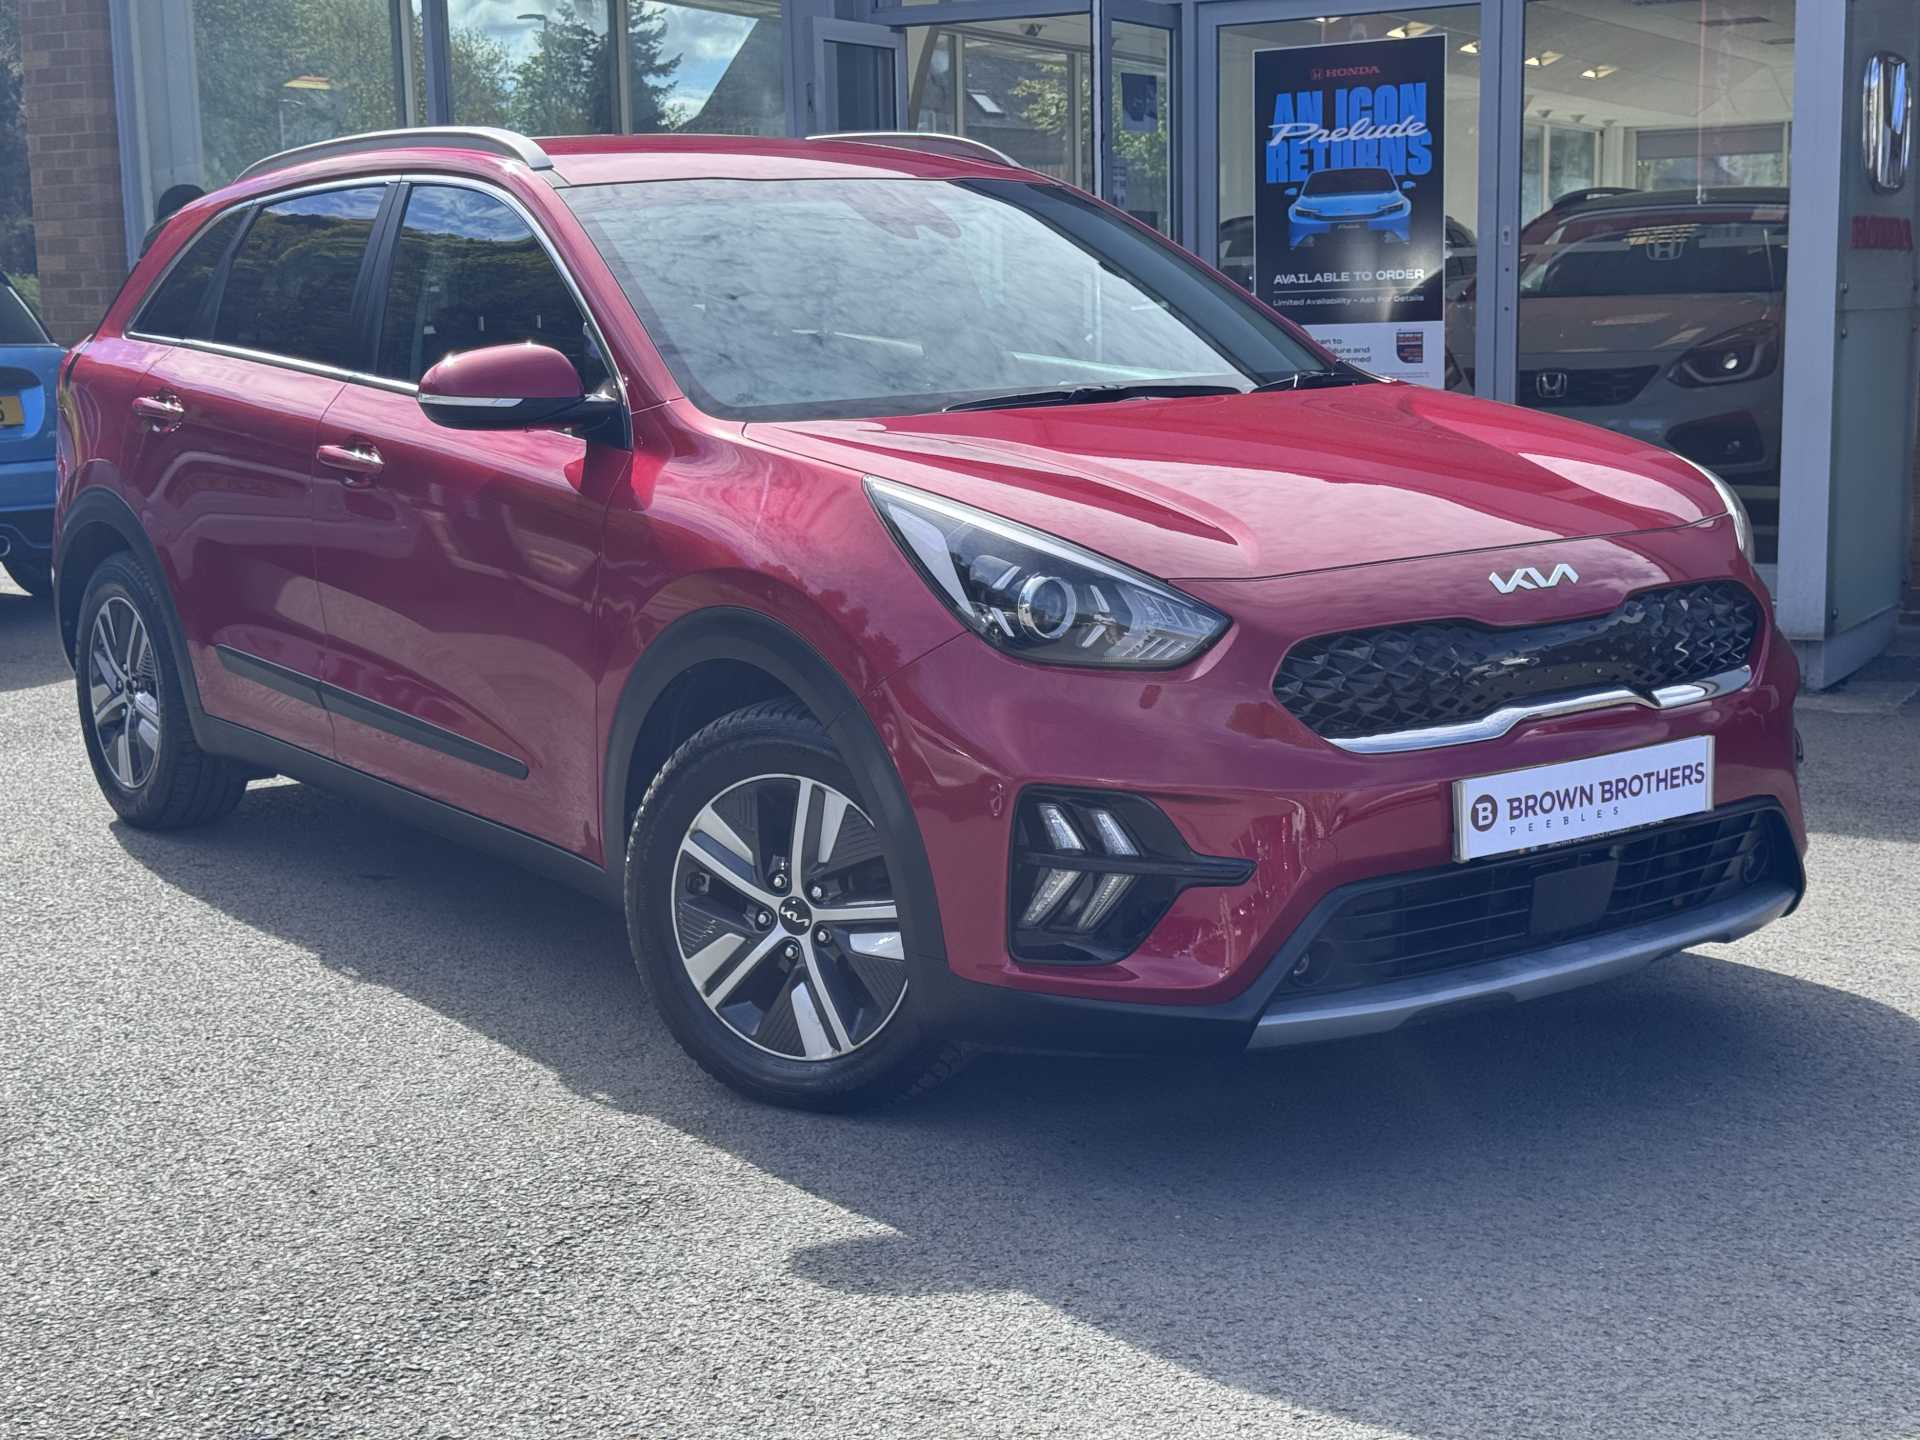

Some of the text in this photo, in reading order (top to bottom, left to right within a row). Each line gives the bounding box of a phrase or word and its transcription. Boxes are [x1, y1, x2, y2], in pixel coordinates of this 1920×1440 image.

[1325, 66, 1380, 77] HONDA
[1268, 115, 1428, 146] Prelude
[1273, 268, 1425, 285] AVAILABLE TO ORDER
[1506, 783, 1593, 820] BROWN
[1598, 762, 1706, 804] BROTHERS
[1510, 806, 1620, 836] PEEBLES
